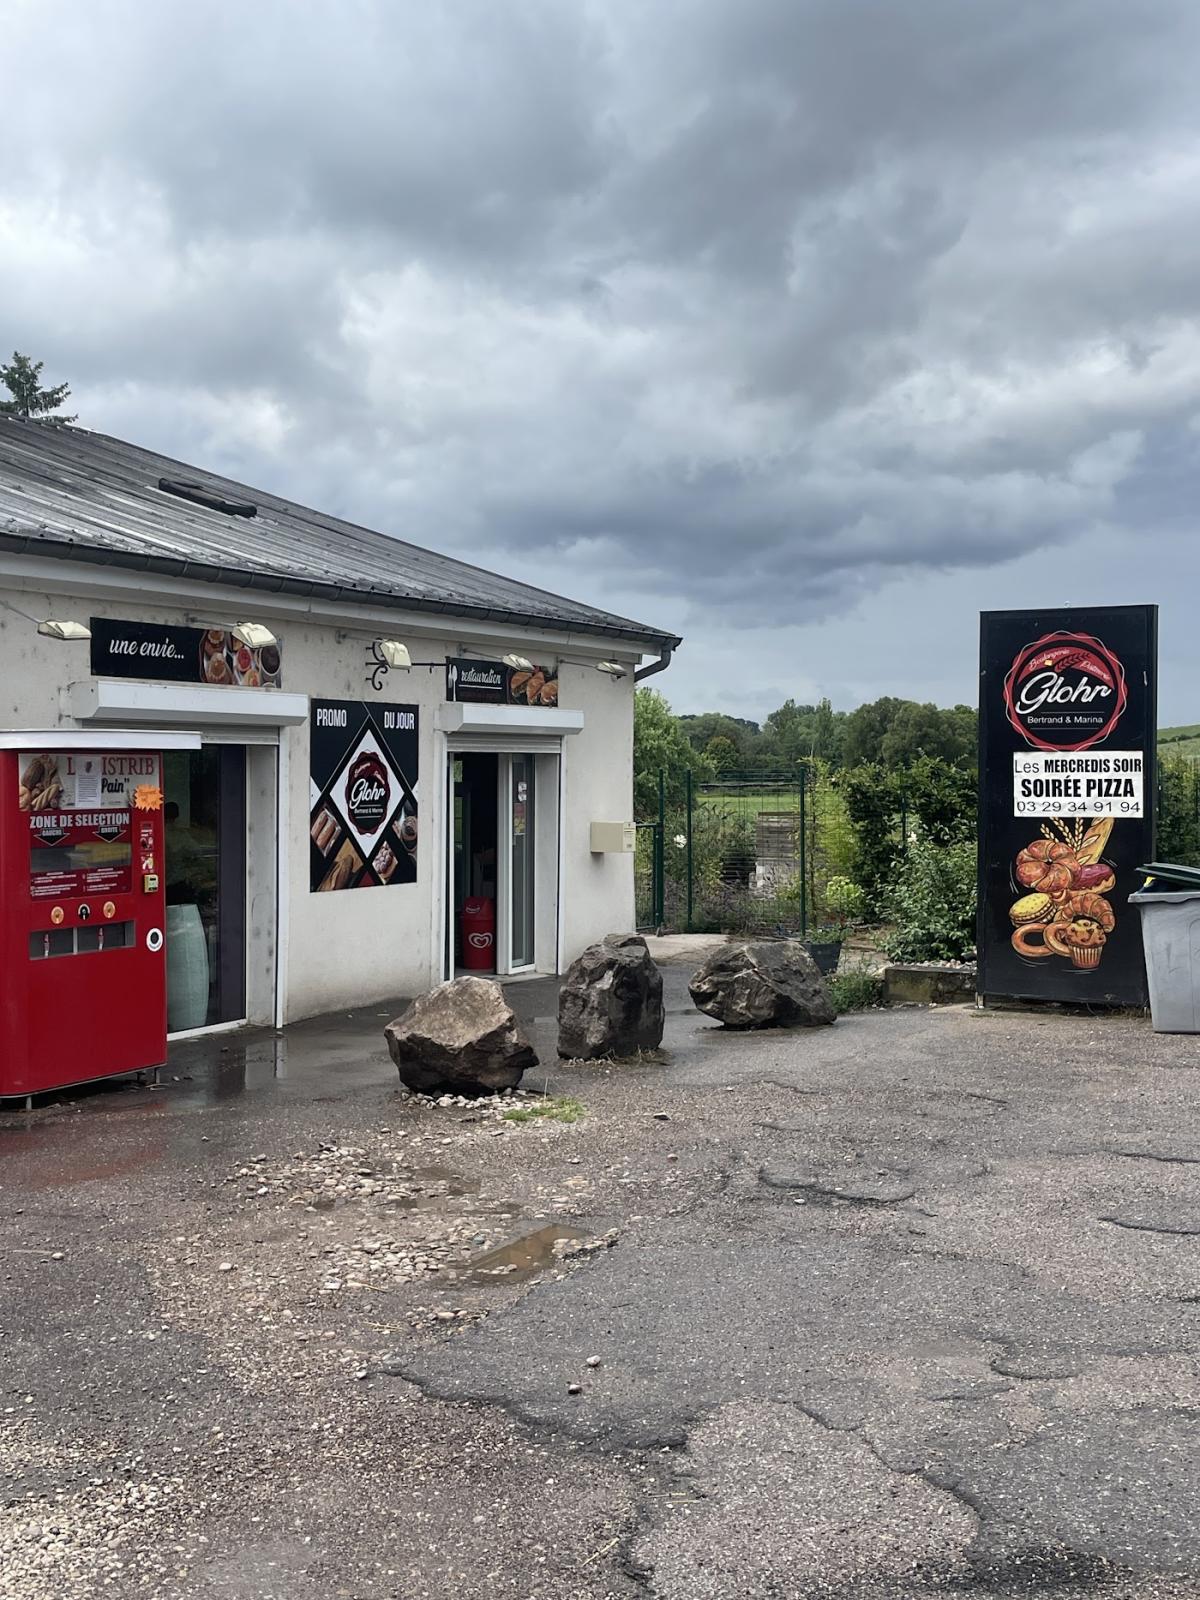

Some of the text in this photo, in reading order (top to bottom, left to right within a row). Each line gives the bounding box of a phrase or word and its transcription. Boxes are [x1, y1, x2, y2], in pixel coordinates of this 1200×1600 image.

[109, 637, 185, 659] une envie...
[461, 667, 501, 684] restauration
[1015, 671, 1112, 714] Glohr
[316, 708, 347, 727] PROMO
[384, 711, 415, 730] DU JOUR
[1027, 716, 1103, 724] Bertrand & Marina
[101, 757, 154, 775] ISTRIB
[1014, 758, 1142, 774] Les MERCREDIS SOIR
[349, 779, 386, 809] Glohr
[1021, 775, 1135, 798] SOIRÉE PIZZA
[1017, 801, 1141, 812] 03 29 34 91 94
[30, 813, 130, 829] ZONE DE SELECTION
